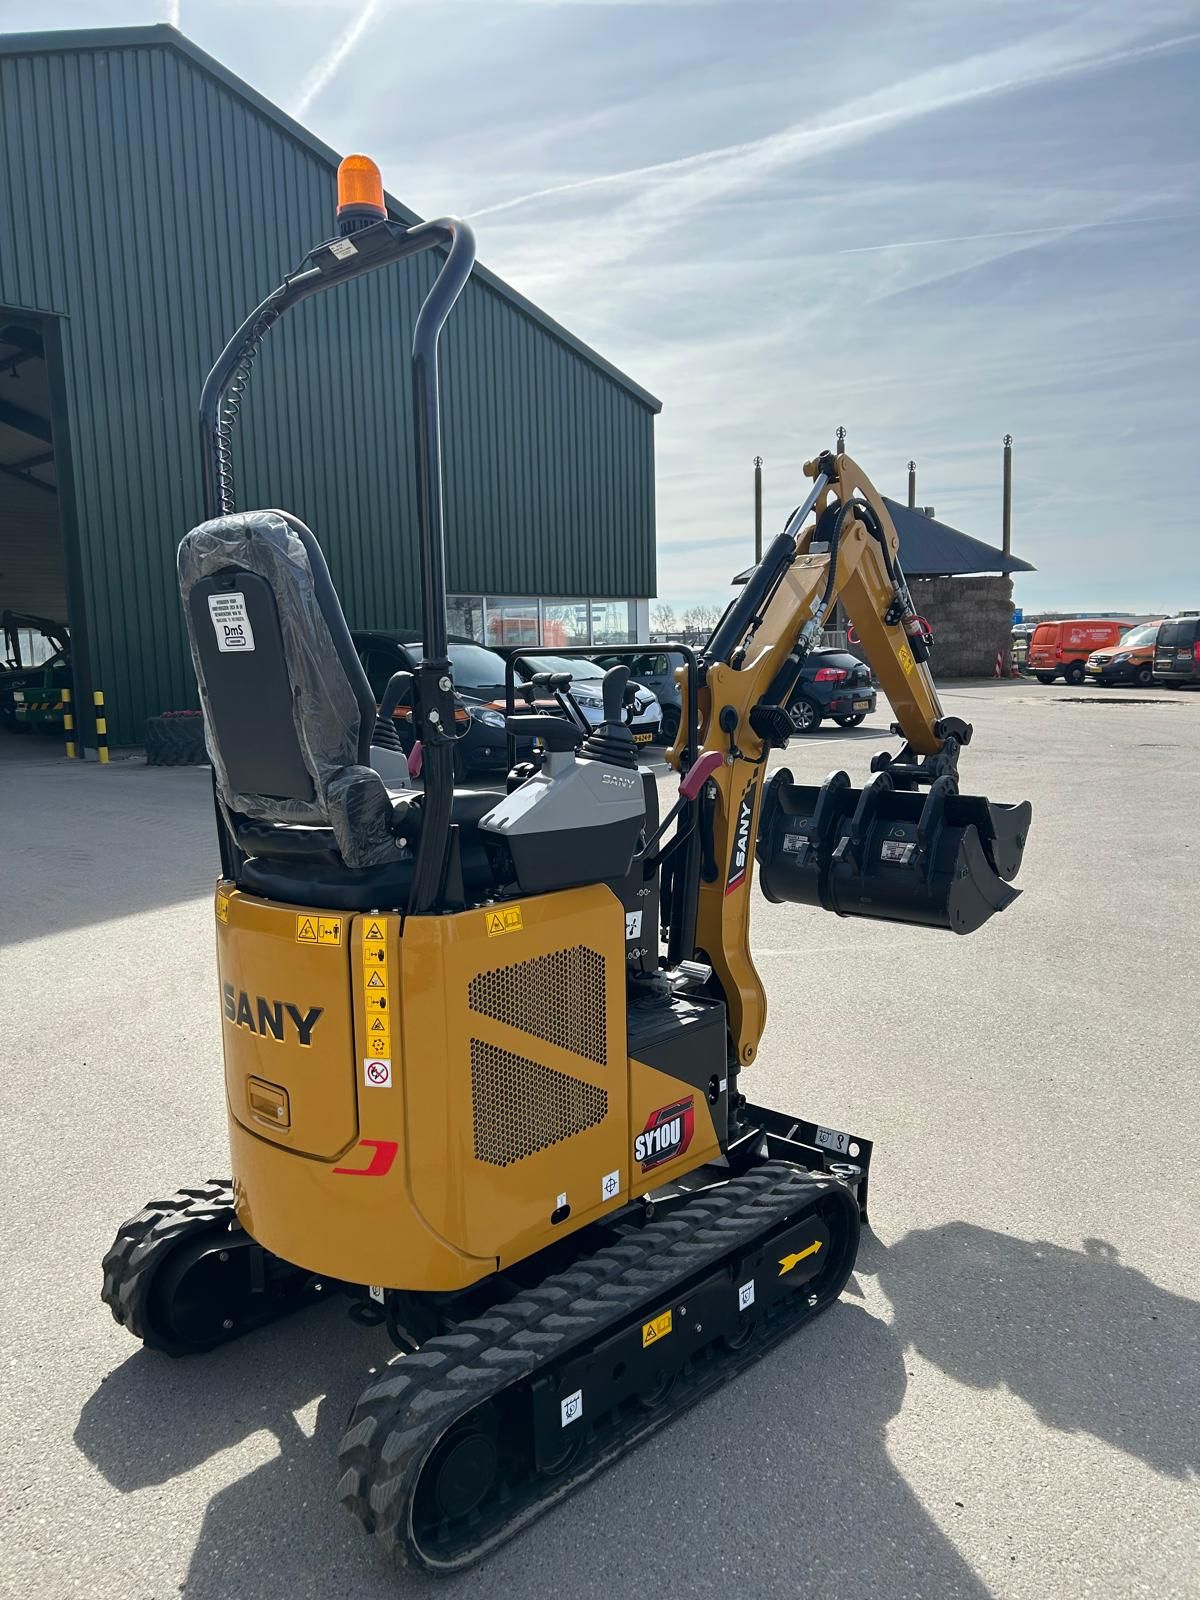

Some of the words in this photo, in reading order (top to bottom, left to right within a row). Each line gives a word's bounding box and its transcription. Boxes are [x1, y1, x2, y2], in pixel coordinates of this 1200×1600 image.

[224, 625, 243, 636] DmS
[601, 774, 635, 788] SANY
[735, 801, 751, 867] SANY
[223, 981, 325, 1048] SANY
[635, 1117, 680, 1161] SY10U
